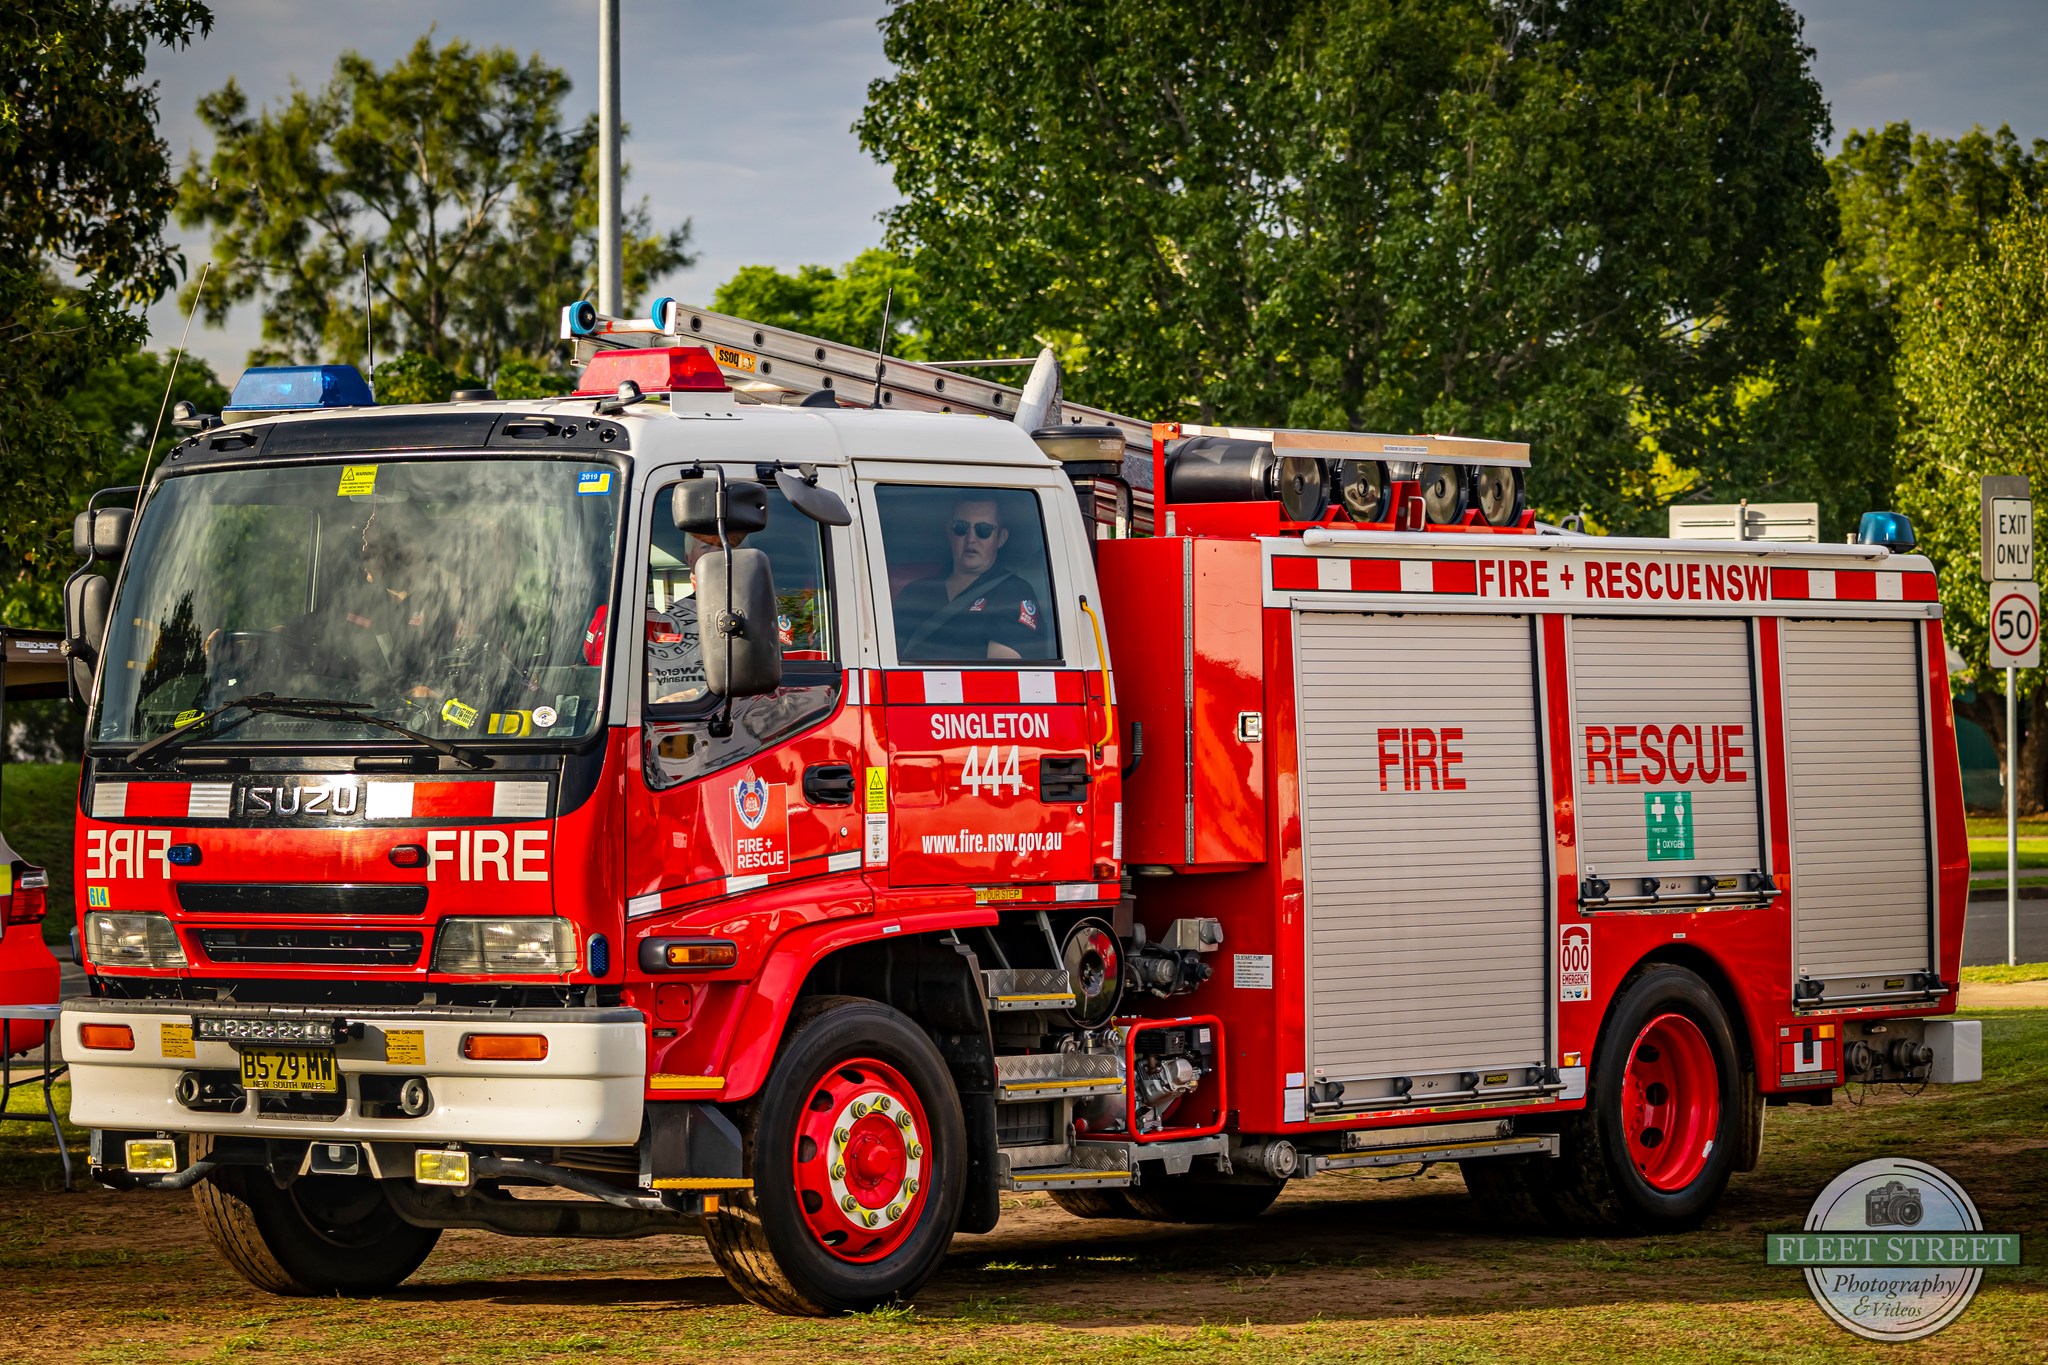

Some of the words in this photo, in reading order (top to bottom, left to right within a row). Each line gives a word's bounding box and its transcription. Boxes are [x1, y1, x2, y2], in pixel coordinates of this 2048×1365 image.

[719, 350, 739, 367] boss
[1999, 514, 2027, 534] EXIT
[1997, 544, 2030, 564] ONLY
[1479, 559, 1550, 598] FIRE
[1999, 610, 2032, 640] 50
[931, 712, 1050, 740] SINGLETON
[1377, 727, 1467, 792] FIRE
[1585, 724, 1748, 785] RESCUE
[961, 745, 1023, 797] 444
[238, 786, 359, 816] ISUZU
[737, 838, 764, 853] FIRE
[921, 829, 1062, 857] www.fire.nsw.gov.au
[1662, 840, 1685, 849] OXYGEN
[427, 830, 549, 881] FIRE
[737, 851, 784, 869] RESCUE
[89, 887, 107, 906] 614
[983, 890, 1000, 900] YOUR
[1001, 889, 1020, 899] STEP
[1562, 945, 1589, 972] 000
[1562, 973, 1589, 985] EMERGENCY
[272, 1081, 297, 1089] SOUTH
[301, 1082, 326, 1090] WALES
